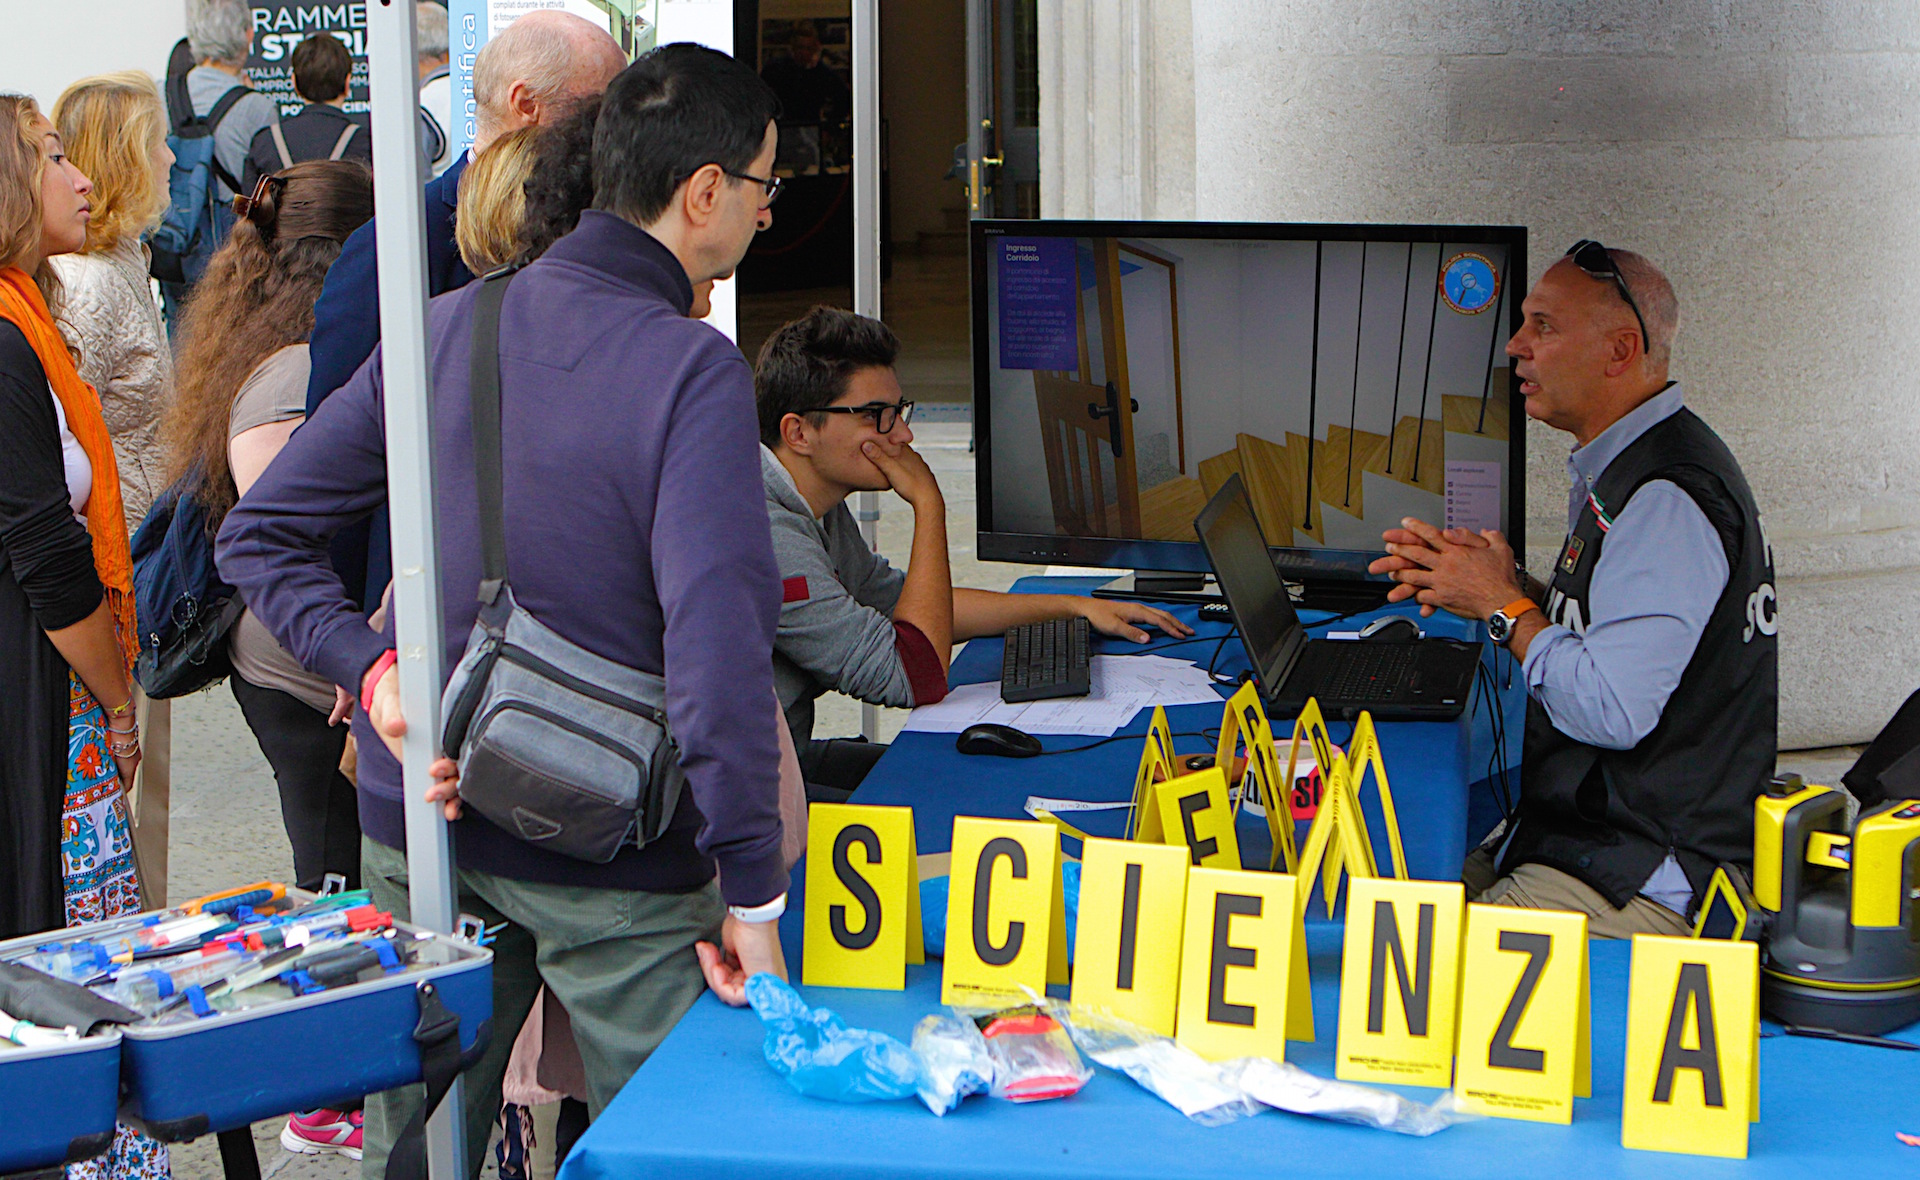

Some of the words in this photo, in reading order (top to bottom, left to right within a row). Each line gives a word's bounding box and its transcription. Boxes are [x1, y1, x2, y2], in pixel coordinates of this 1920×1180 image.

[517, 0, 538, 9] durante
[1006, 244, 1037, 253] Ingresso
[1006, 253, 1040, 262] Corridoio
